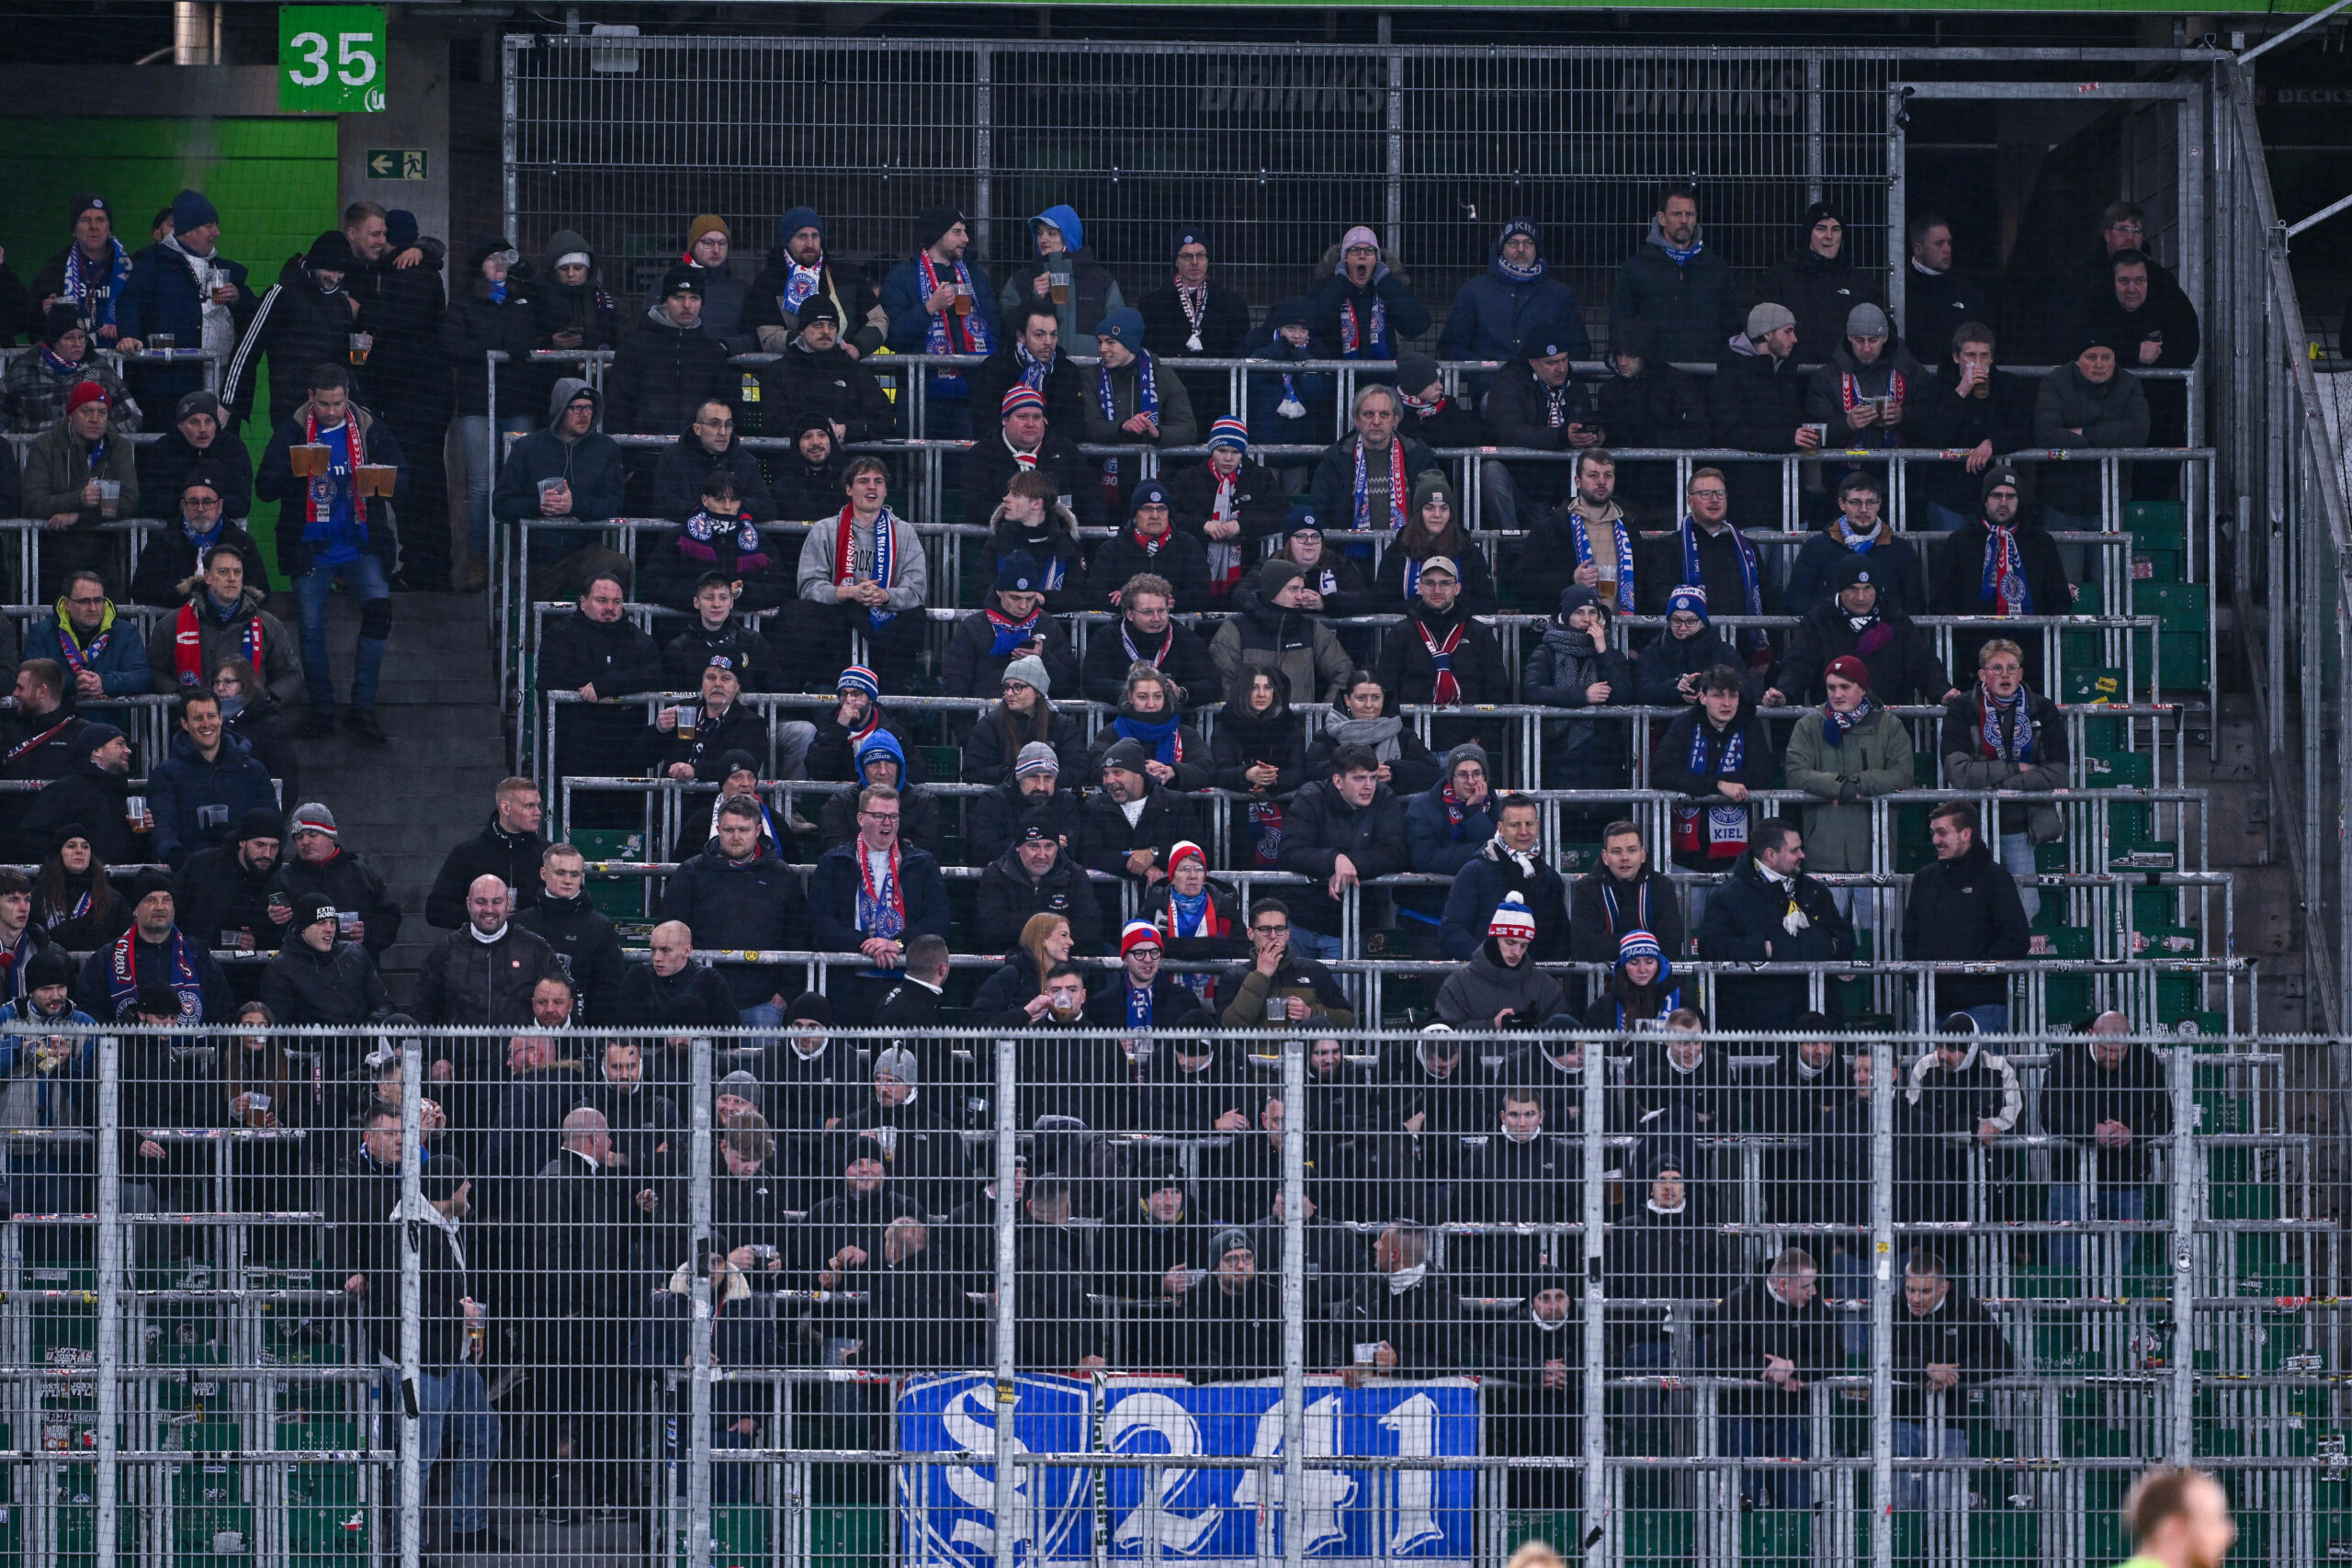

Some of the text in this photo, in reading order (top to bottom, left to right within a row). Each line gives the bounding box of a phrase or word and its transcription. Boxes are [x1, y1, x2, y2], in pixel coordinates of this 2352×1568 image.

[289, 32, 377, 88] 35
[1199, 64, 1390, 114] DRINKS
[1614, 68, 1803, 117] DRINKS
[1713, 828, 1744, 840] KIEL
[1714, 809, 1744, 823] VON 1900
[1102, 1391, 1444, 1556] 241
